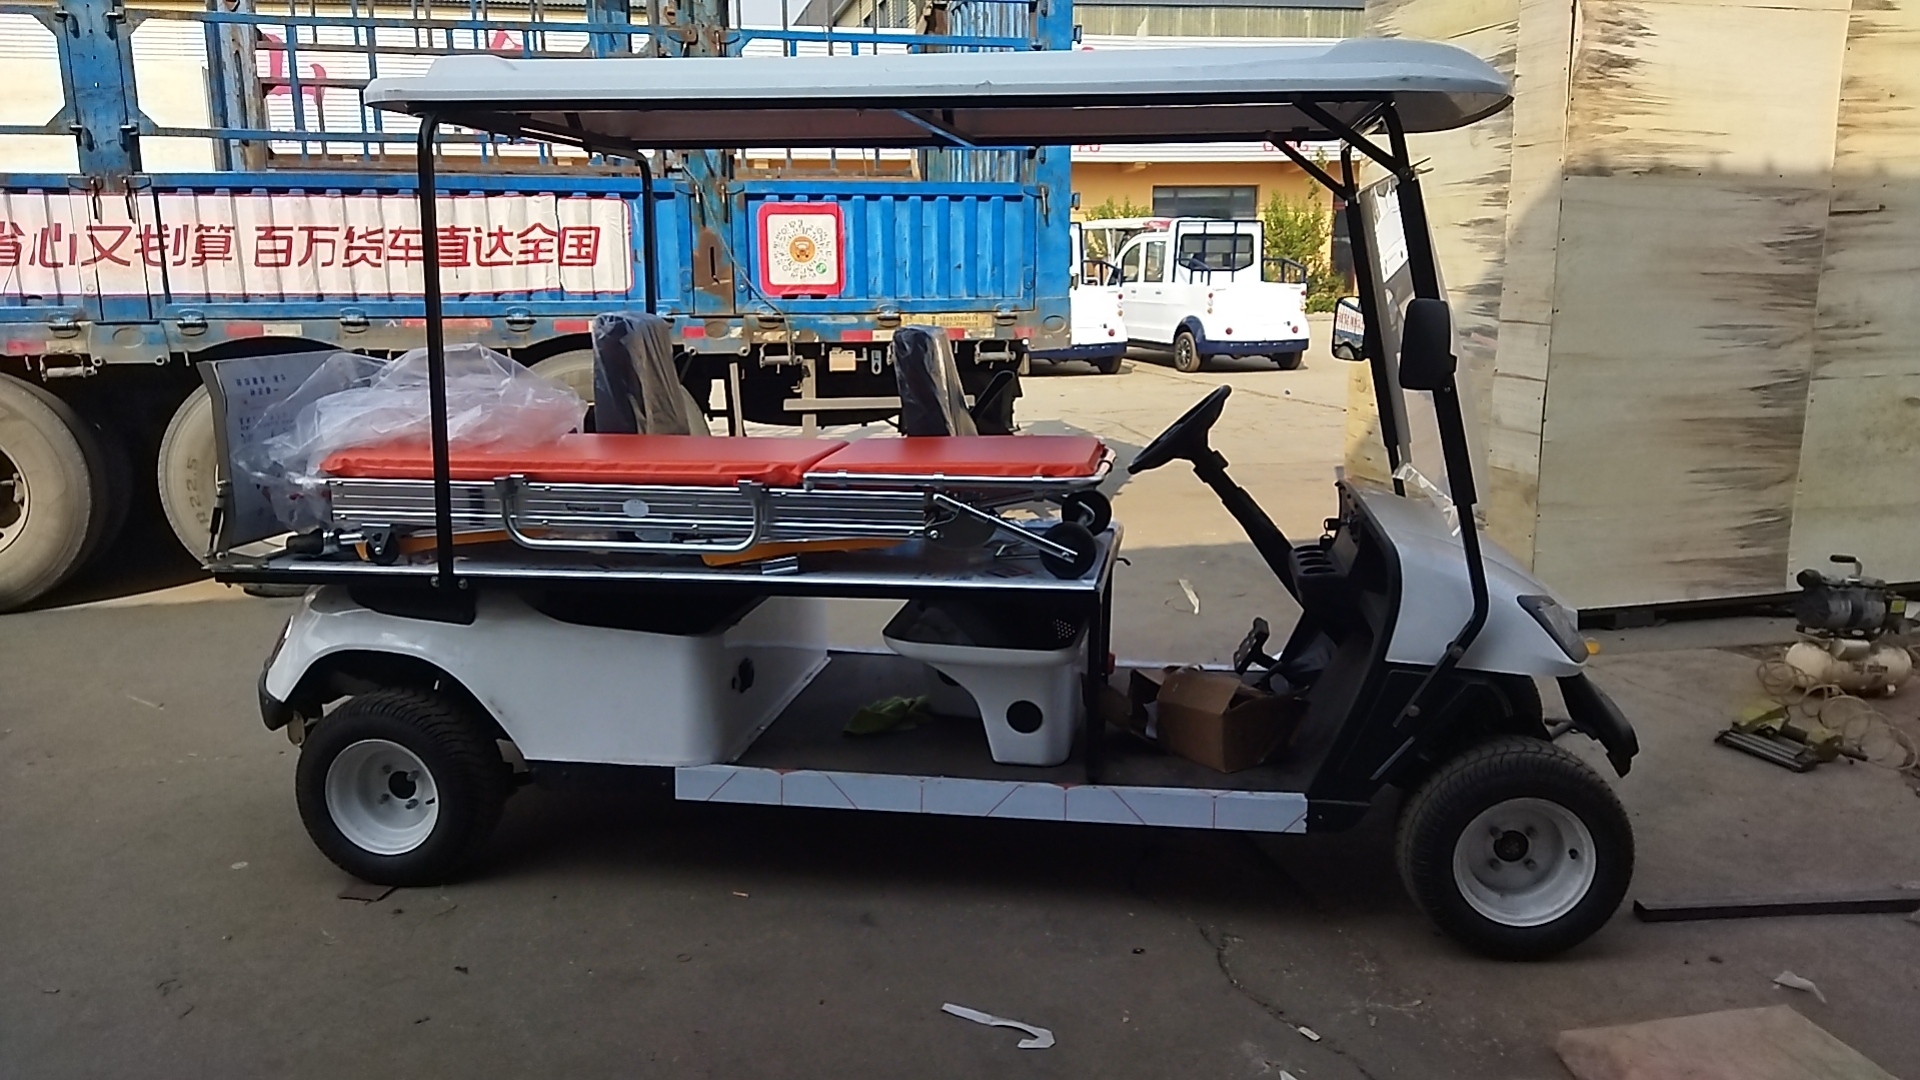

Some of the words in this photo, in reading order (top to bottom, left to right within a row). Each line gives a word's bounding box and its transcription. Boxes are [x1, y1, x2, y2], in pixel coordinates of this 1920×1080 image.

[254, 221, 601, 268] 百万货车直达全国
